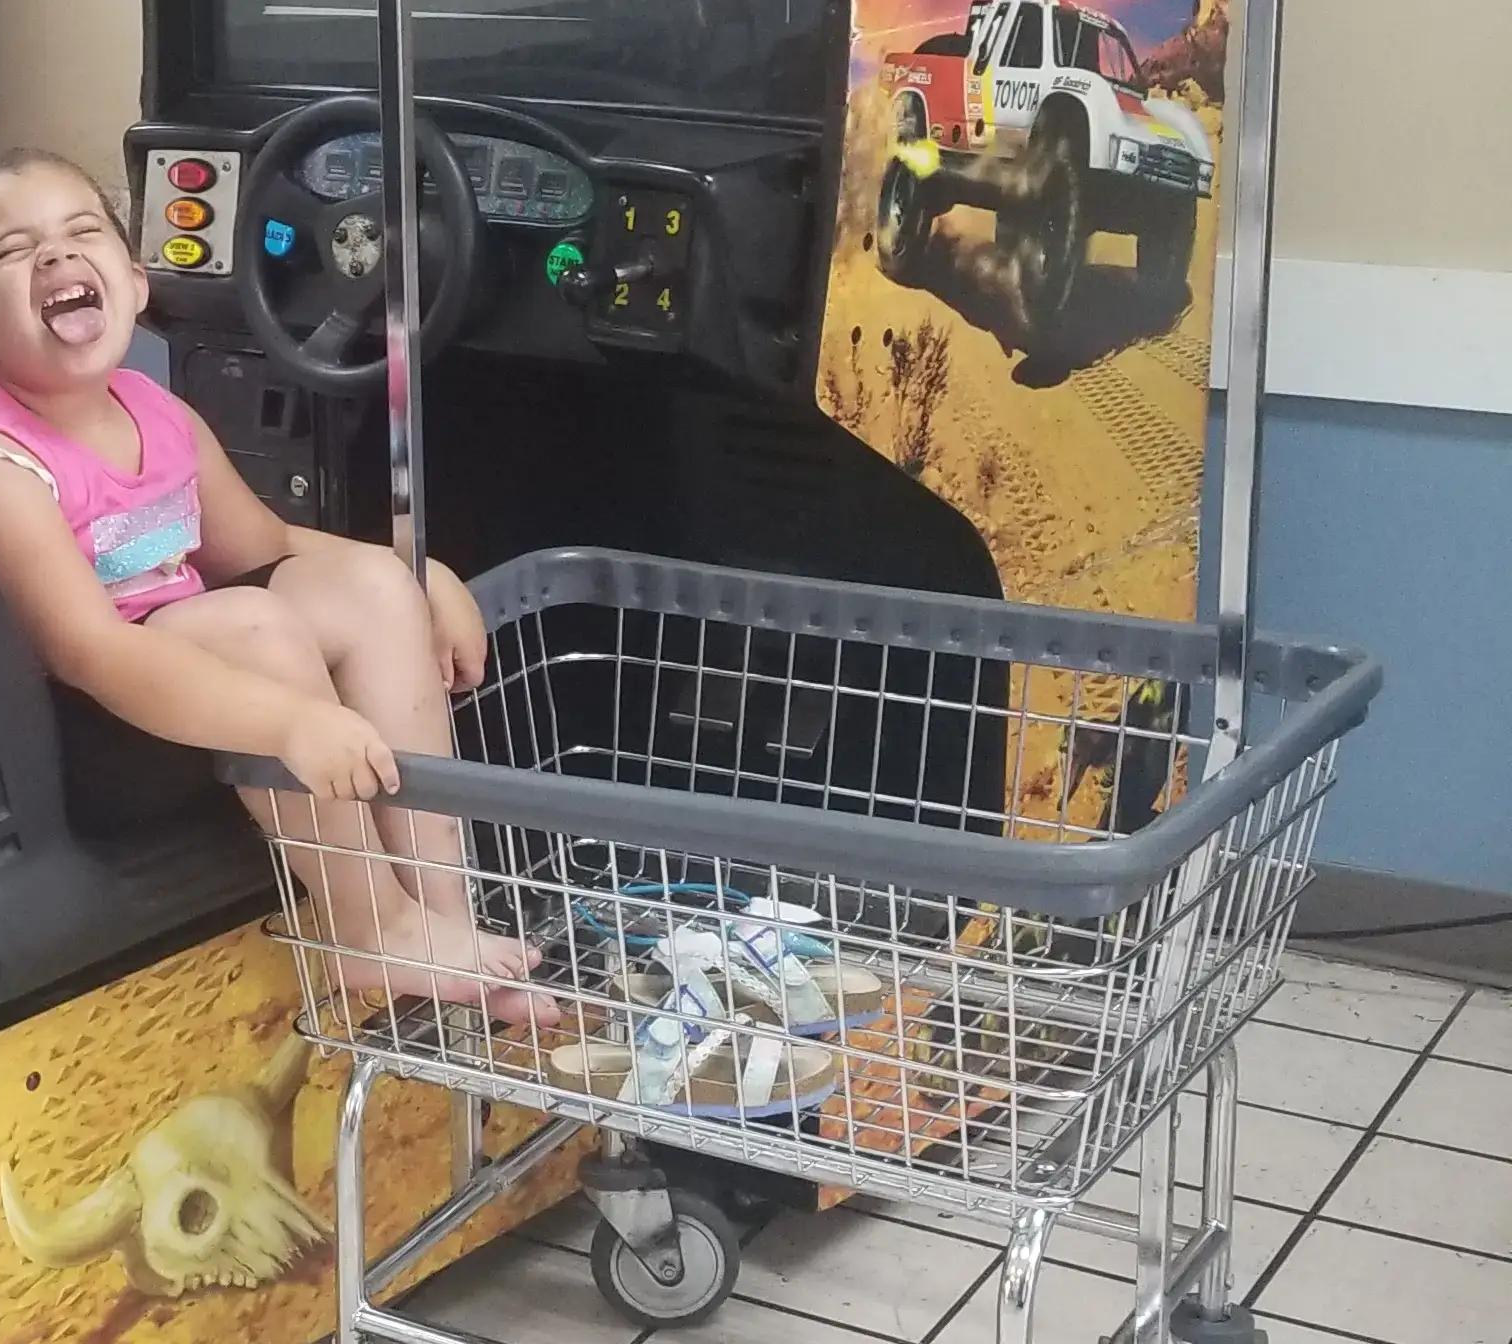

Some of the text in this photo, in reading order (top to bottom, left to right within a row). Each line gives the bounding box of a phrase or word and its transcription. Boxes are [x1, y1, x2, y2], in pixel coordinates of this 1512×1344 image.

[994, 80, 1040, 111] TOYOTA
[625, 207, 681, 235] 1 3
[614, 283, 672, 311] 2 4
